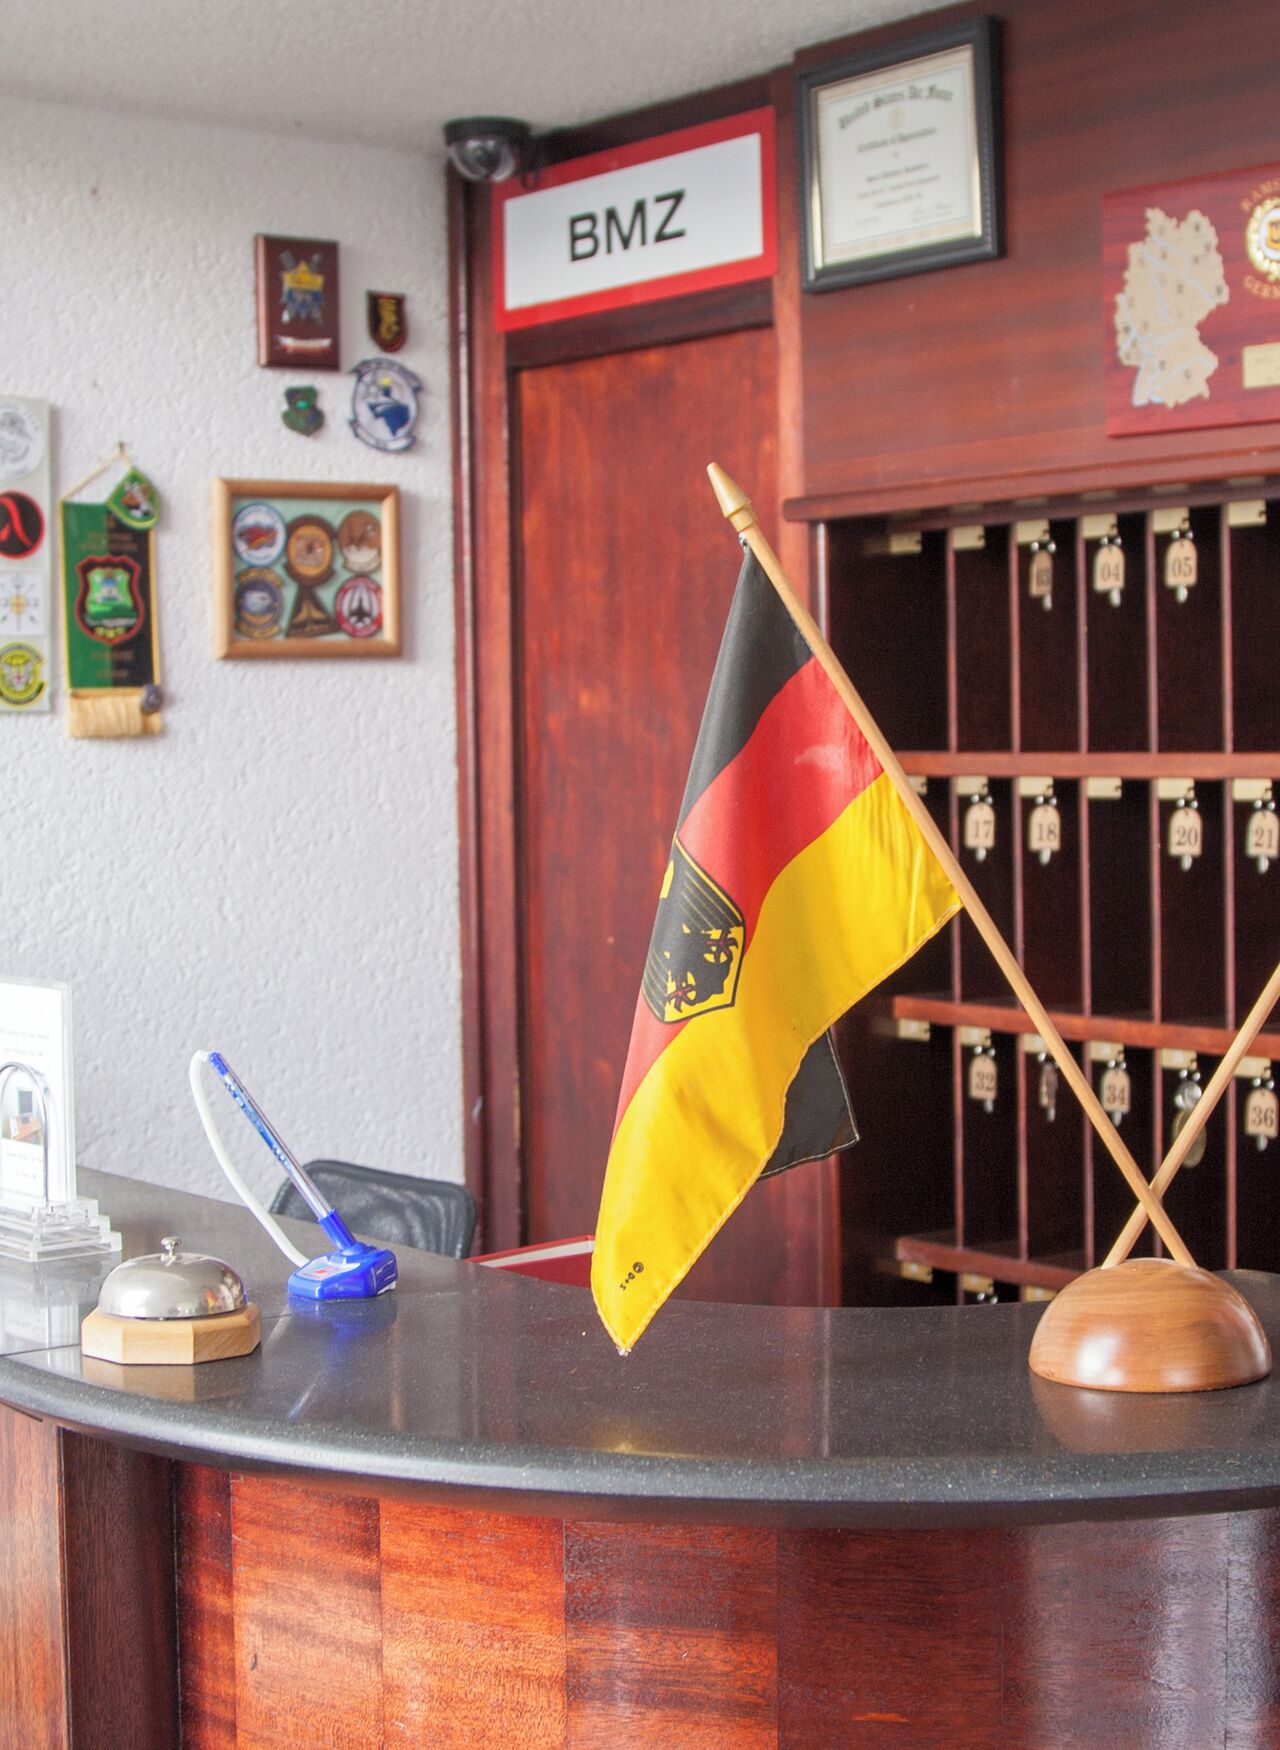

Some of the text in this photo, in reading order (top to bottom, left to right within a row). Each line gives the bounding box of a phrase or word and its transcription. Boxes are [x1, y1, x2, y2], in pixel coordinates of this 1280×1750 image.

[568, 187, 687, 263] BMZ
[1101, 559, 1120, 583] 04
[1170, 556, 1193, 578] 05
[974, 819, 992, 840] 17
[1037, 821, 1058, 842] 18
[1176, 825, 1199, 848] 20
[1255, 826, 1274, 850] 21
[976, 1071, 995, 1091] 32
[1107, 1084, 1127, 1106] 34
[1254, 1105, 1276, 1129] 36
